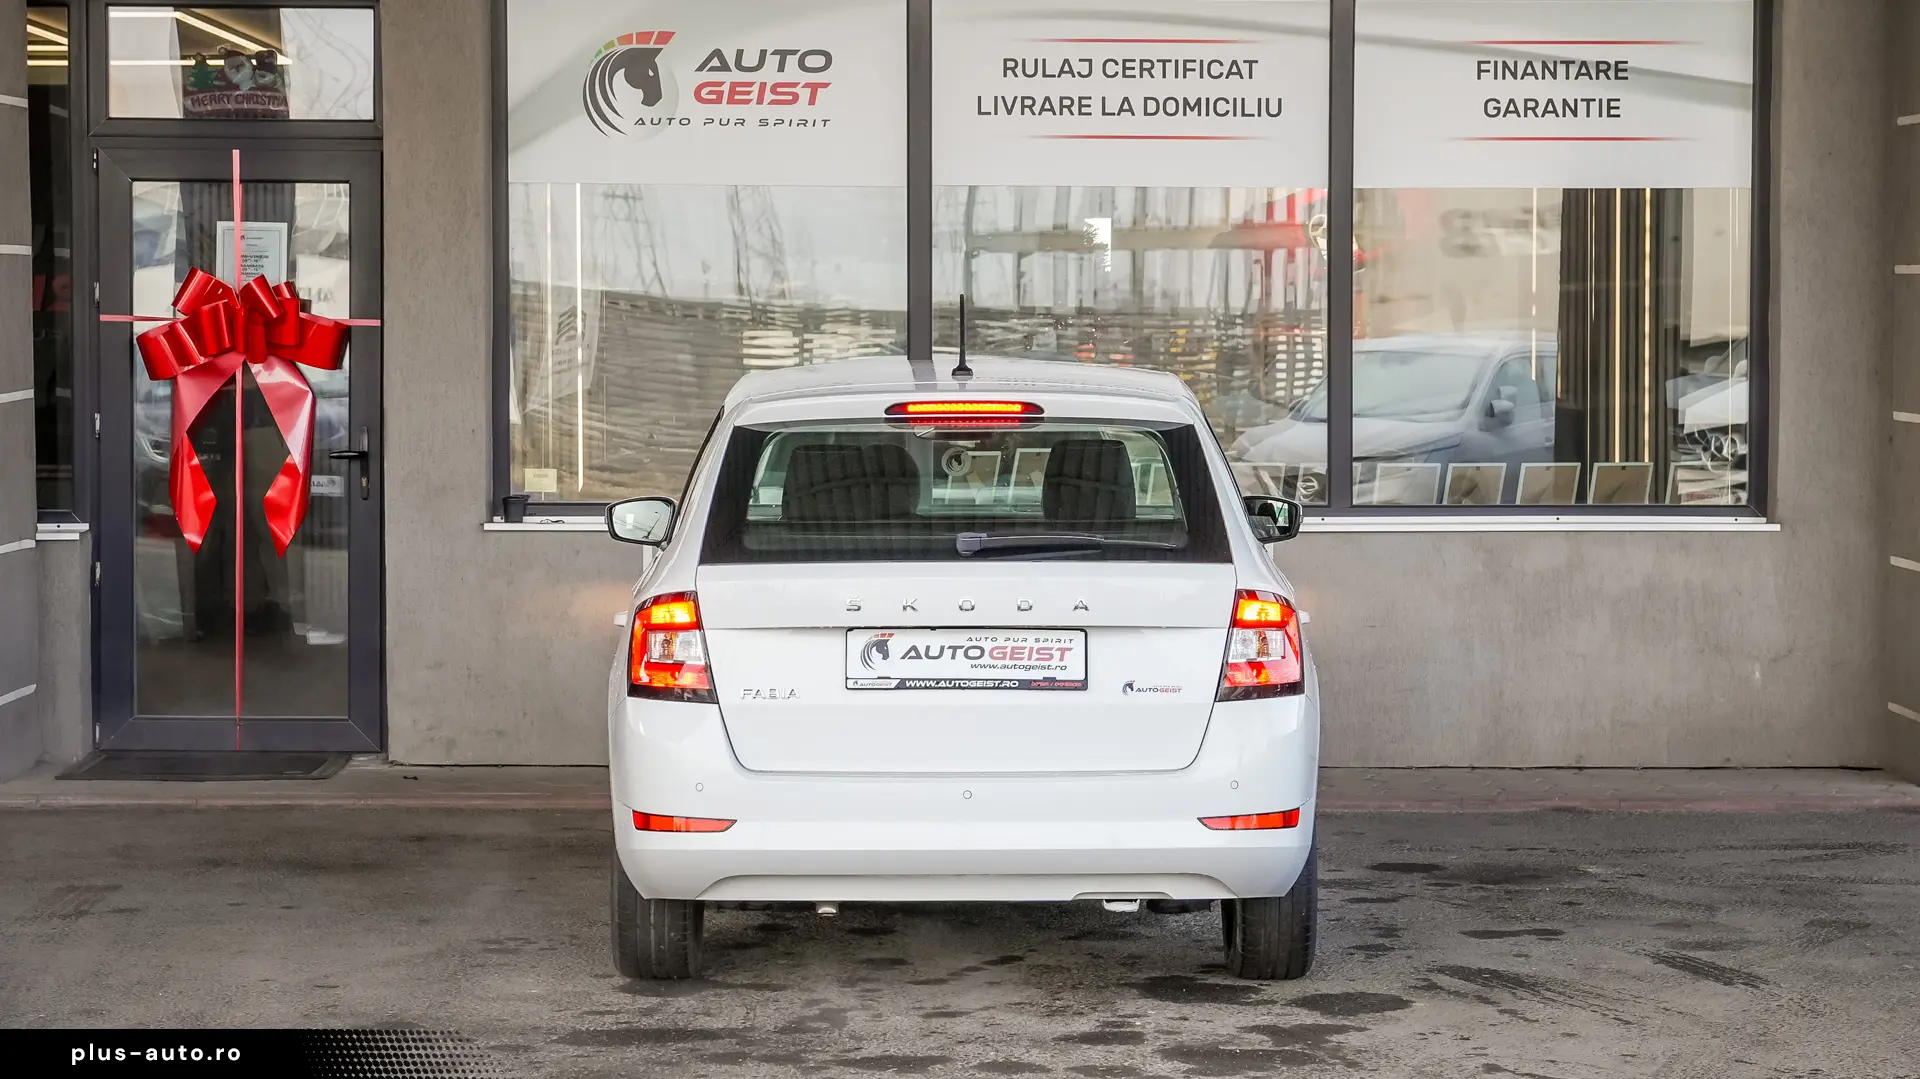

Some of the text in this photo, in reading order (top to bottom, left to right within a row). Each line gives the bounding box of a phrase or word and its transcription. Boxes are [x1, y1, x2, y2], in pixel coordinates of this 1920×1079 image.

[694, 48, 833, 73] AUTO
[1002, 57, 1259, 80] RULAJ CERTIFICAT
[1476, 60, 1629, 81] FINANTARE
[190, 93, 232, 109] MERRY
[693, 80, 832, 106] GEIST
[976, 95, 1283, 118] LIVRARE LA DOMICILIU
[1483, 97, 1621, 118] GARANTIE
[633, 117, 832, 128] AUTO PUR SPIRIT
[969, 662, 1068, 672] www.autogeist.ro
[740, 688, 801, 700] FABIA
[905, 680, 1019, 688] WWW.AUTOGEIST.RO
